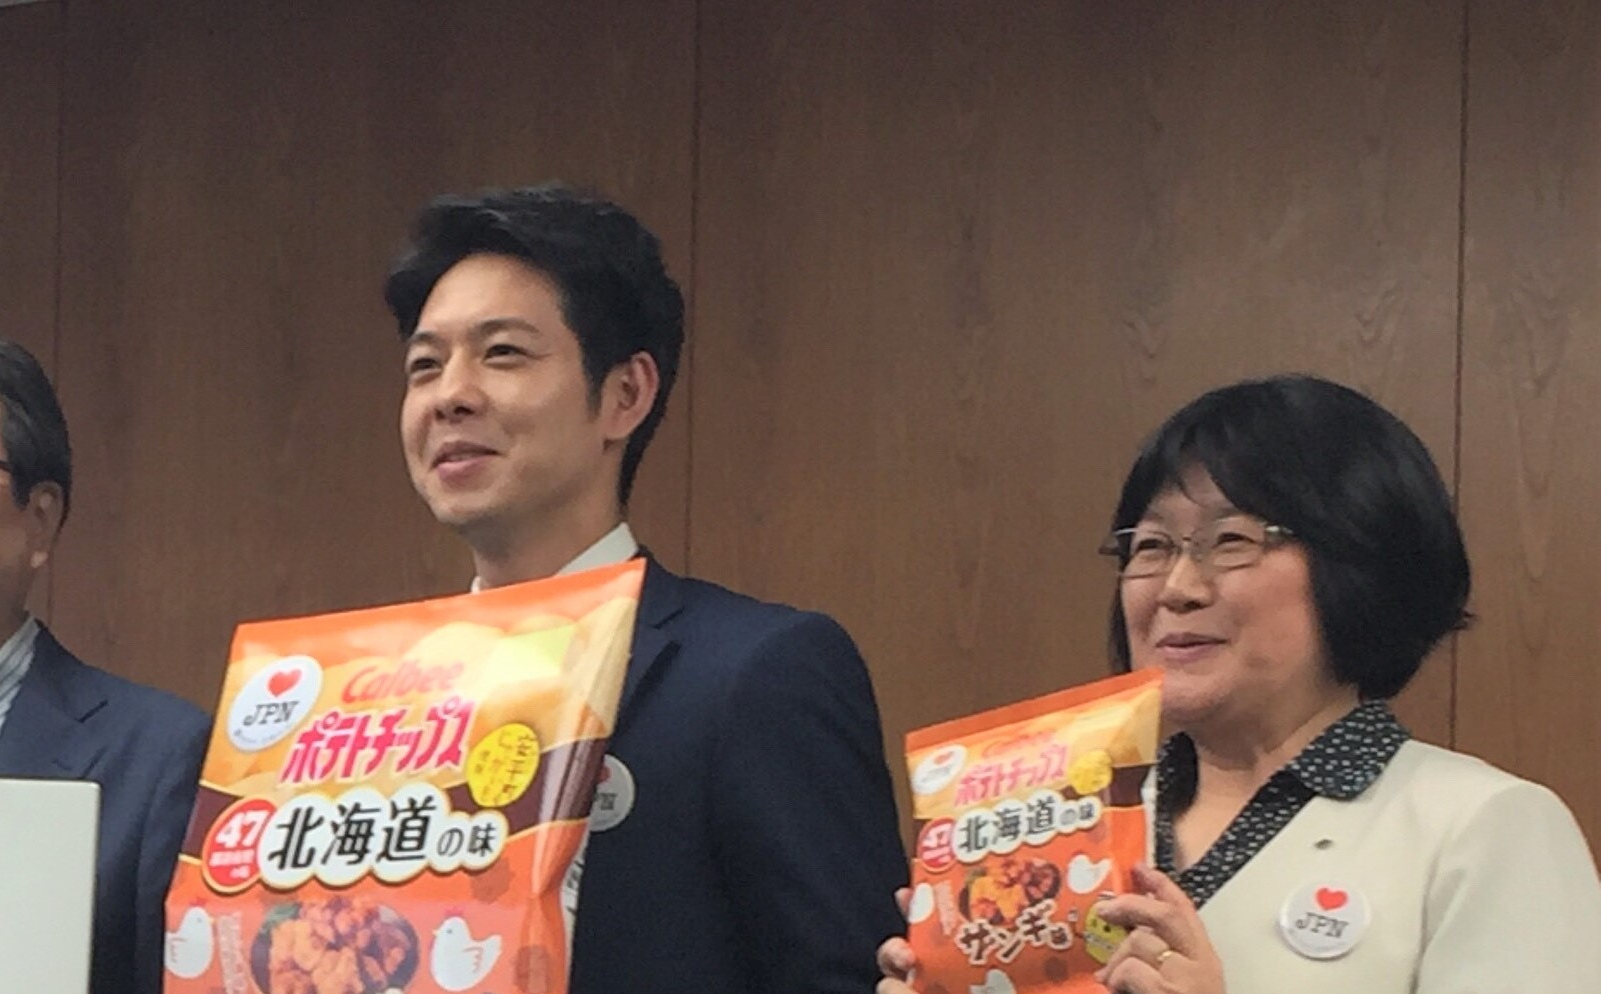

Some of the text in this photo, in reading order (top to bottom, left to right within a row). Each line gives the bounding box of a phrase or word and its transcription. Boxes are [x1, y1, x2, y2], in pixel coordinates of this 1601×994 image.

[342, 659, 465, 704] Calbee
[243, 700, 300, 727] JPN
[279, 695, 476, 784] ポテトチップス
[215, 810, 271, 849] 47
[268, 795, 497, 871] 北海道の味
